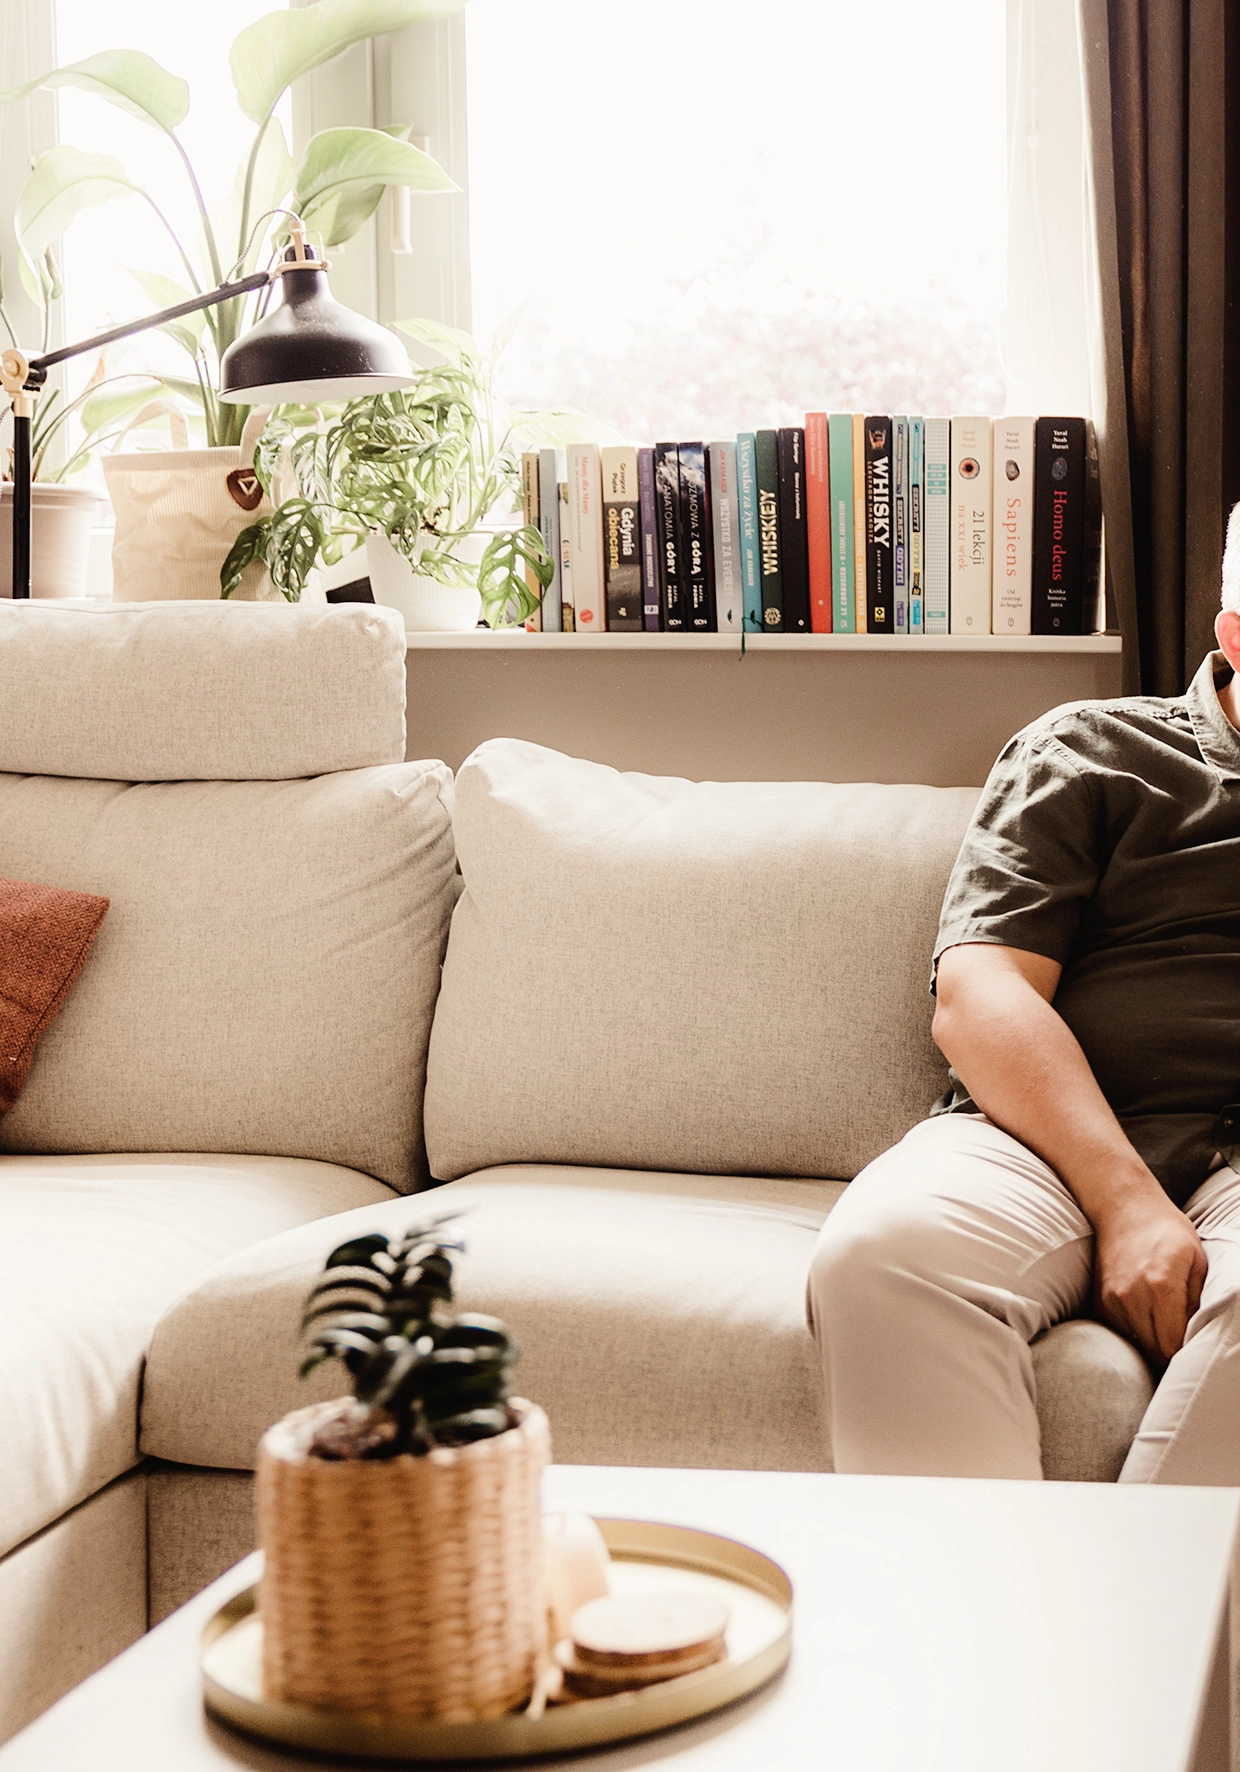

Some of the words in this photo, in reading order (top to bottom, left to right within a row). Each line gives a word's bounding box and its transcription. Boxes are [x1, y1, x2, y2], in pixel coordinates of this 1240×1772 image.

[1053, 429, 1068, 437] Yuval
[619, 462, 628, 495] Grzegorz
[740, 440, 754, 493] Wszystko
[663, 485, 674, 540] ANATOMIA
[688, 478, 700, 529] OZMOWA
[743, 495, 753, 508] za
[873, 456, 890, 548] WHISKY
[958, 505, 966, 518] na
[972, 510, 984, 524] 21
[1053, 490, 1068, 541] Homo
[608, 508, 621, 570] obiecana
[620, 508, 635, 556] Gdynia
[720, 498, 732, 543] WSZYSTKO
[759, 489, 779, 576] WHISK(E)Y
[1002, 498, 1021, 577] Sapiens
[666, 541, 677, 575] GÓRY
[691, 540, 702, 575] GÓRĄ
[722, 546, 733, 557] ZA
[896, 547, 904, 584] GDYNI
[958, 545, 969, 571] wiek
[969, 529, 985, 566] lekcji
[1052, 543, 1067, 581] deus
[723, 560, 734, 596] EVEREST
[839, 566, 848, 606] CORBUSIER
[840, 607, 848, 616] LE
[1050, 601, 1064, 609] jutra
